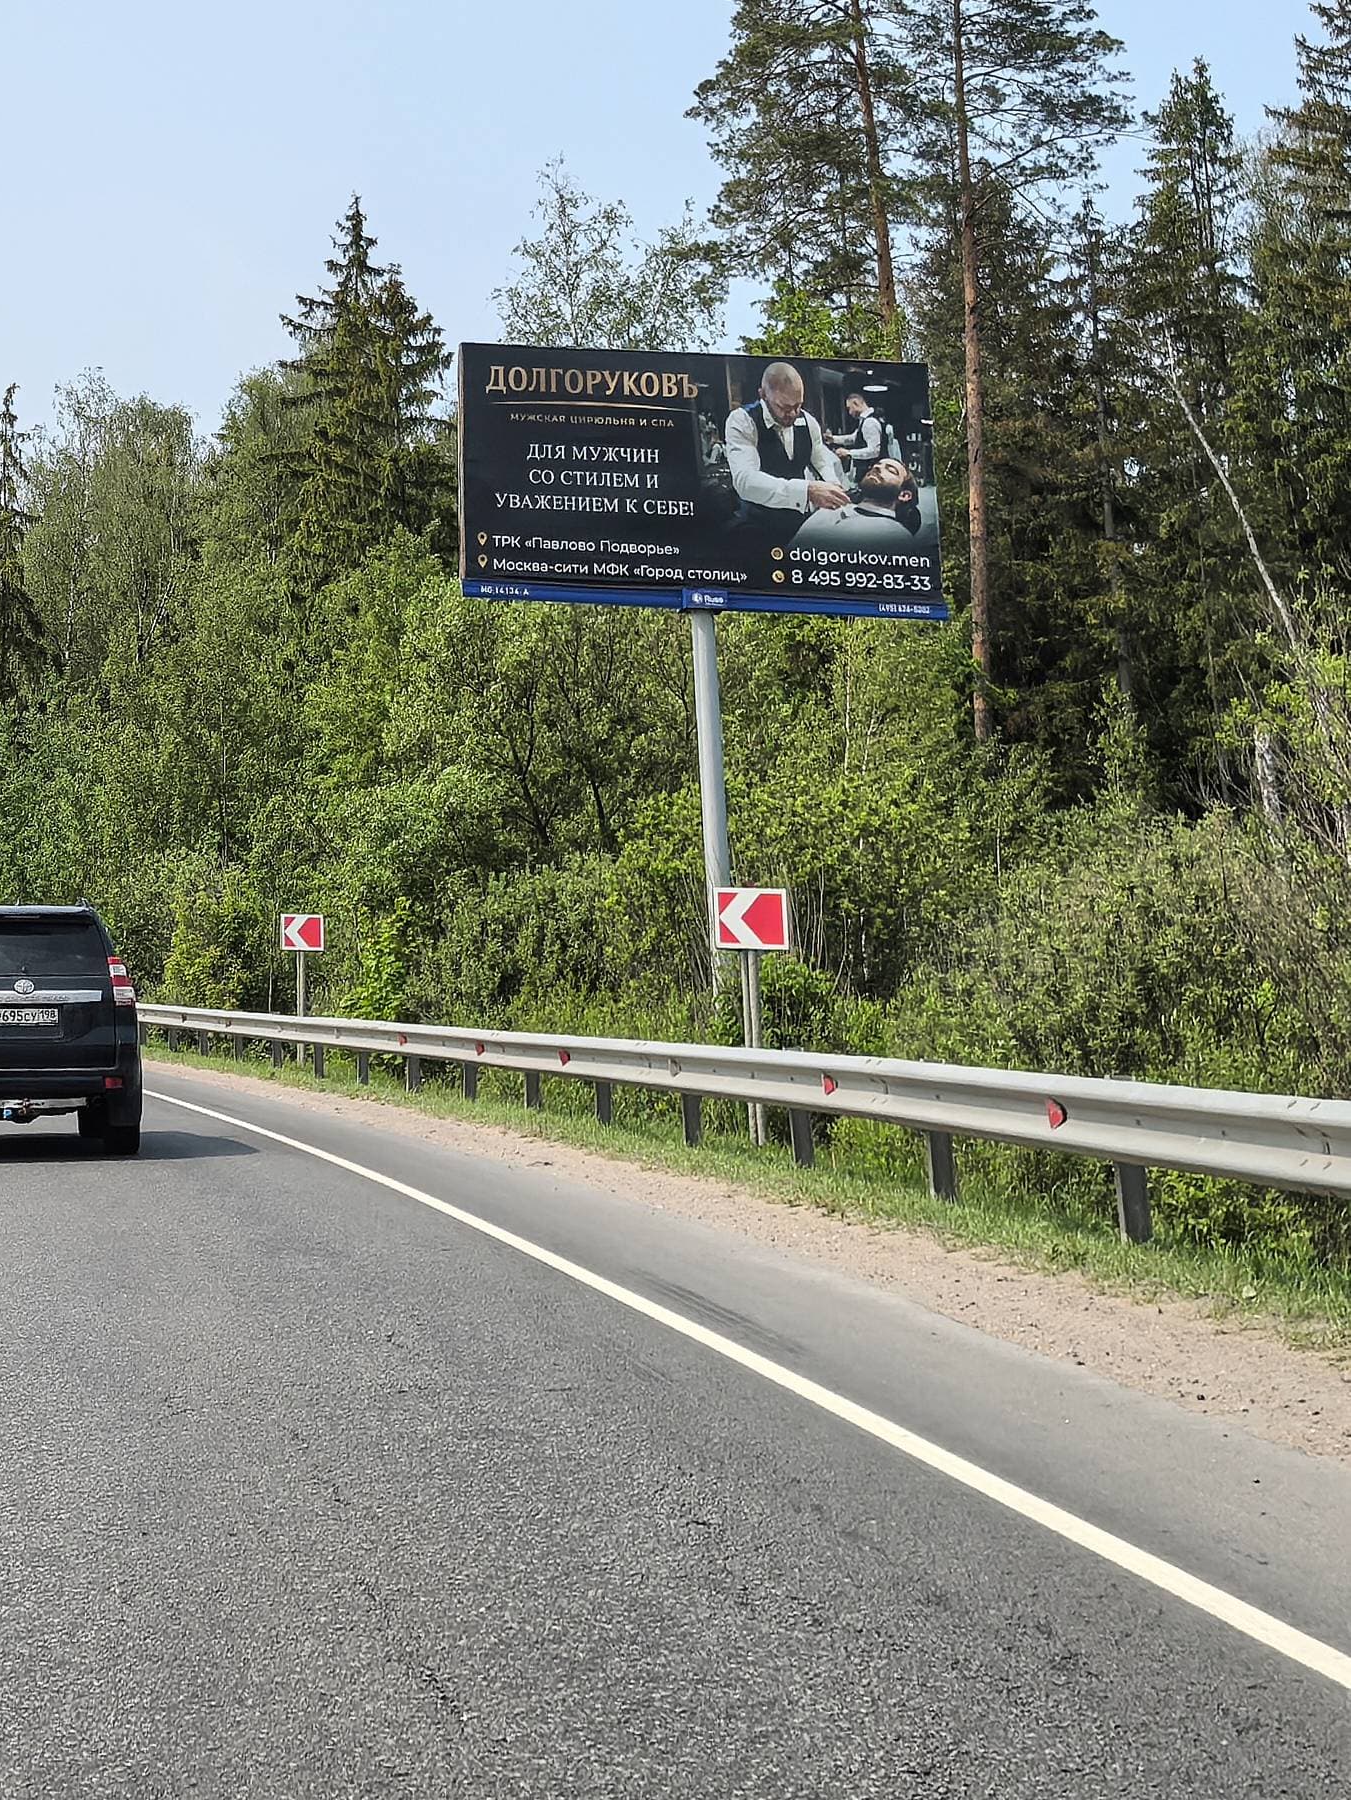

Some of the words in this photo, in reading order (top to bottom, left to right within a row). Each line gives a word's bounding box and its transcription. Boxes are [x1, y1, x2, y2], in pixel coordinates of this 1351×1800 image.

[485, 365, 698, 398] ДОЛГОРУКОВЪ
[510, 413, 566, 424] МУЖСКАЯ
[570, 416, 635, 427] ЦИРЮЛЬНЯ
[639, 418, 647, 427] И
[652, 418, 674, 428] СПА
[526, 444, 565, 460] ДЛЯ
[572, 446, 660, 464] МУЖЧИН
[529, 469, 555, 485] СО
[560, 471, 640, 489] СТИЛЕМ
[646, 474, 659, 489] И
[495, 493, 619, 514] УВАЖЕНИЕМ
[626, 499, 638, 514] К
[643, 500, 694, 516] СЕБЕ!
[492, 535, 521, 549] ТРК
[525, 536, 596, 552] «Павлово
[600, 540, 680, 557] Подворье»
[789, 547, 930, 568] dolgorukov.men
[493, 558, 589, 575] Москва-сити
[593, 562, 629, 577] МФК
[633, 565, 684, 581] «Город
[687, 568, 748, 583] столиц»
[791, 569, 803, 584] 8
[808, 570, 841, 586] 495
[845, 572, 932, 591] 992-83-33
